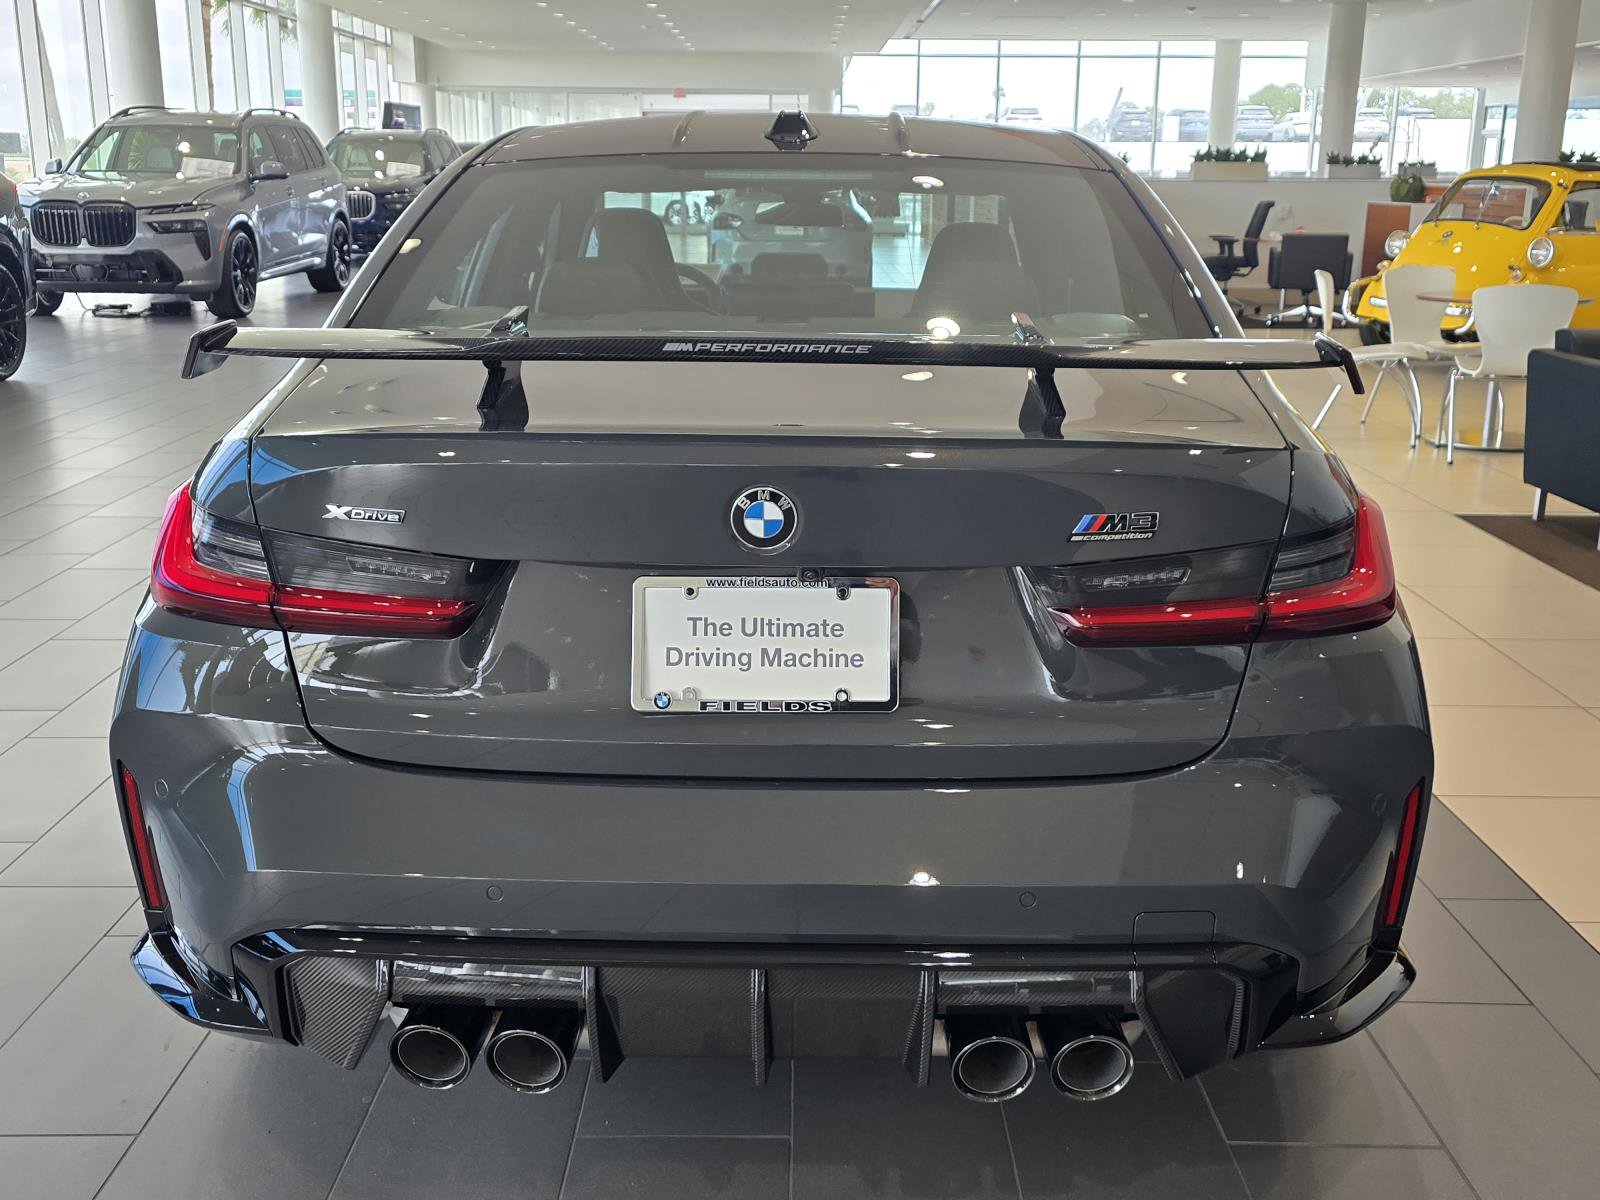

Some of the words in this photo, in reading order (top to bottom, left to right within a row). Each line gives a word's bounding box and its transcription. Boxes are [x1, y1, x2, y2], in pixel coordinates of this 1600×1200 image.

[694, 343, 873, 354] PERFORMANCE
[737, 489, 791, 511] BMW
[1098, 511, 1160, 533] M3
[1083, 532, 1153, 541] competition
[706, 577, 829, 588] www.fieldsauto.com
[687, 616, 733, 638] The
[740, 616, 845, 638] Ultimate
[665, 646, 752, 672] Driving
[760, 647, 865, 669] Machine
[698, 700, 833, 713] FIELDS
